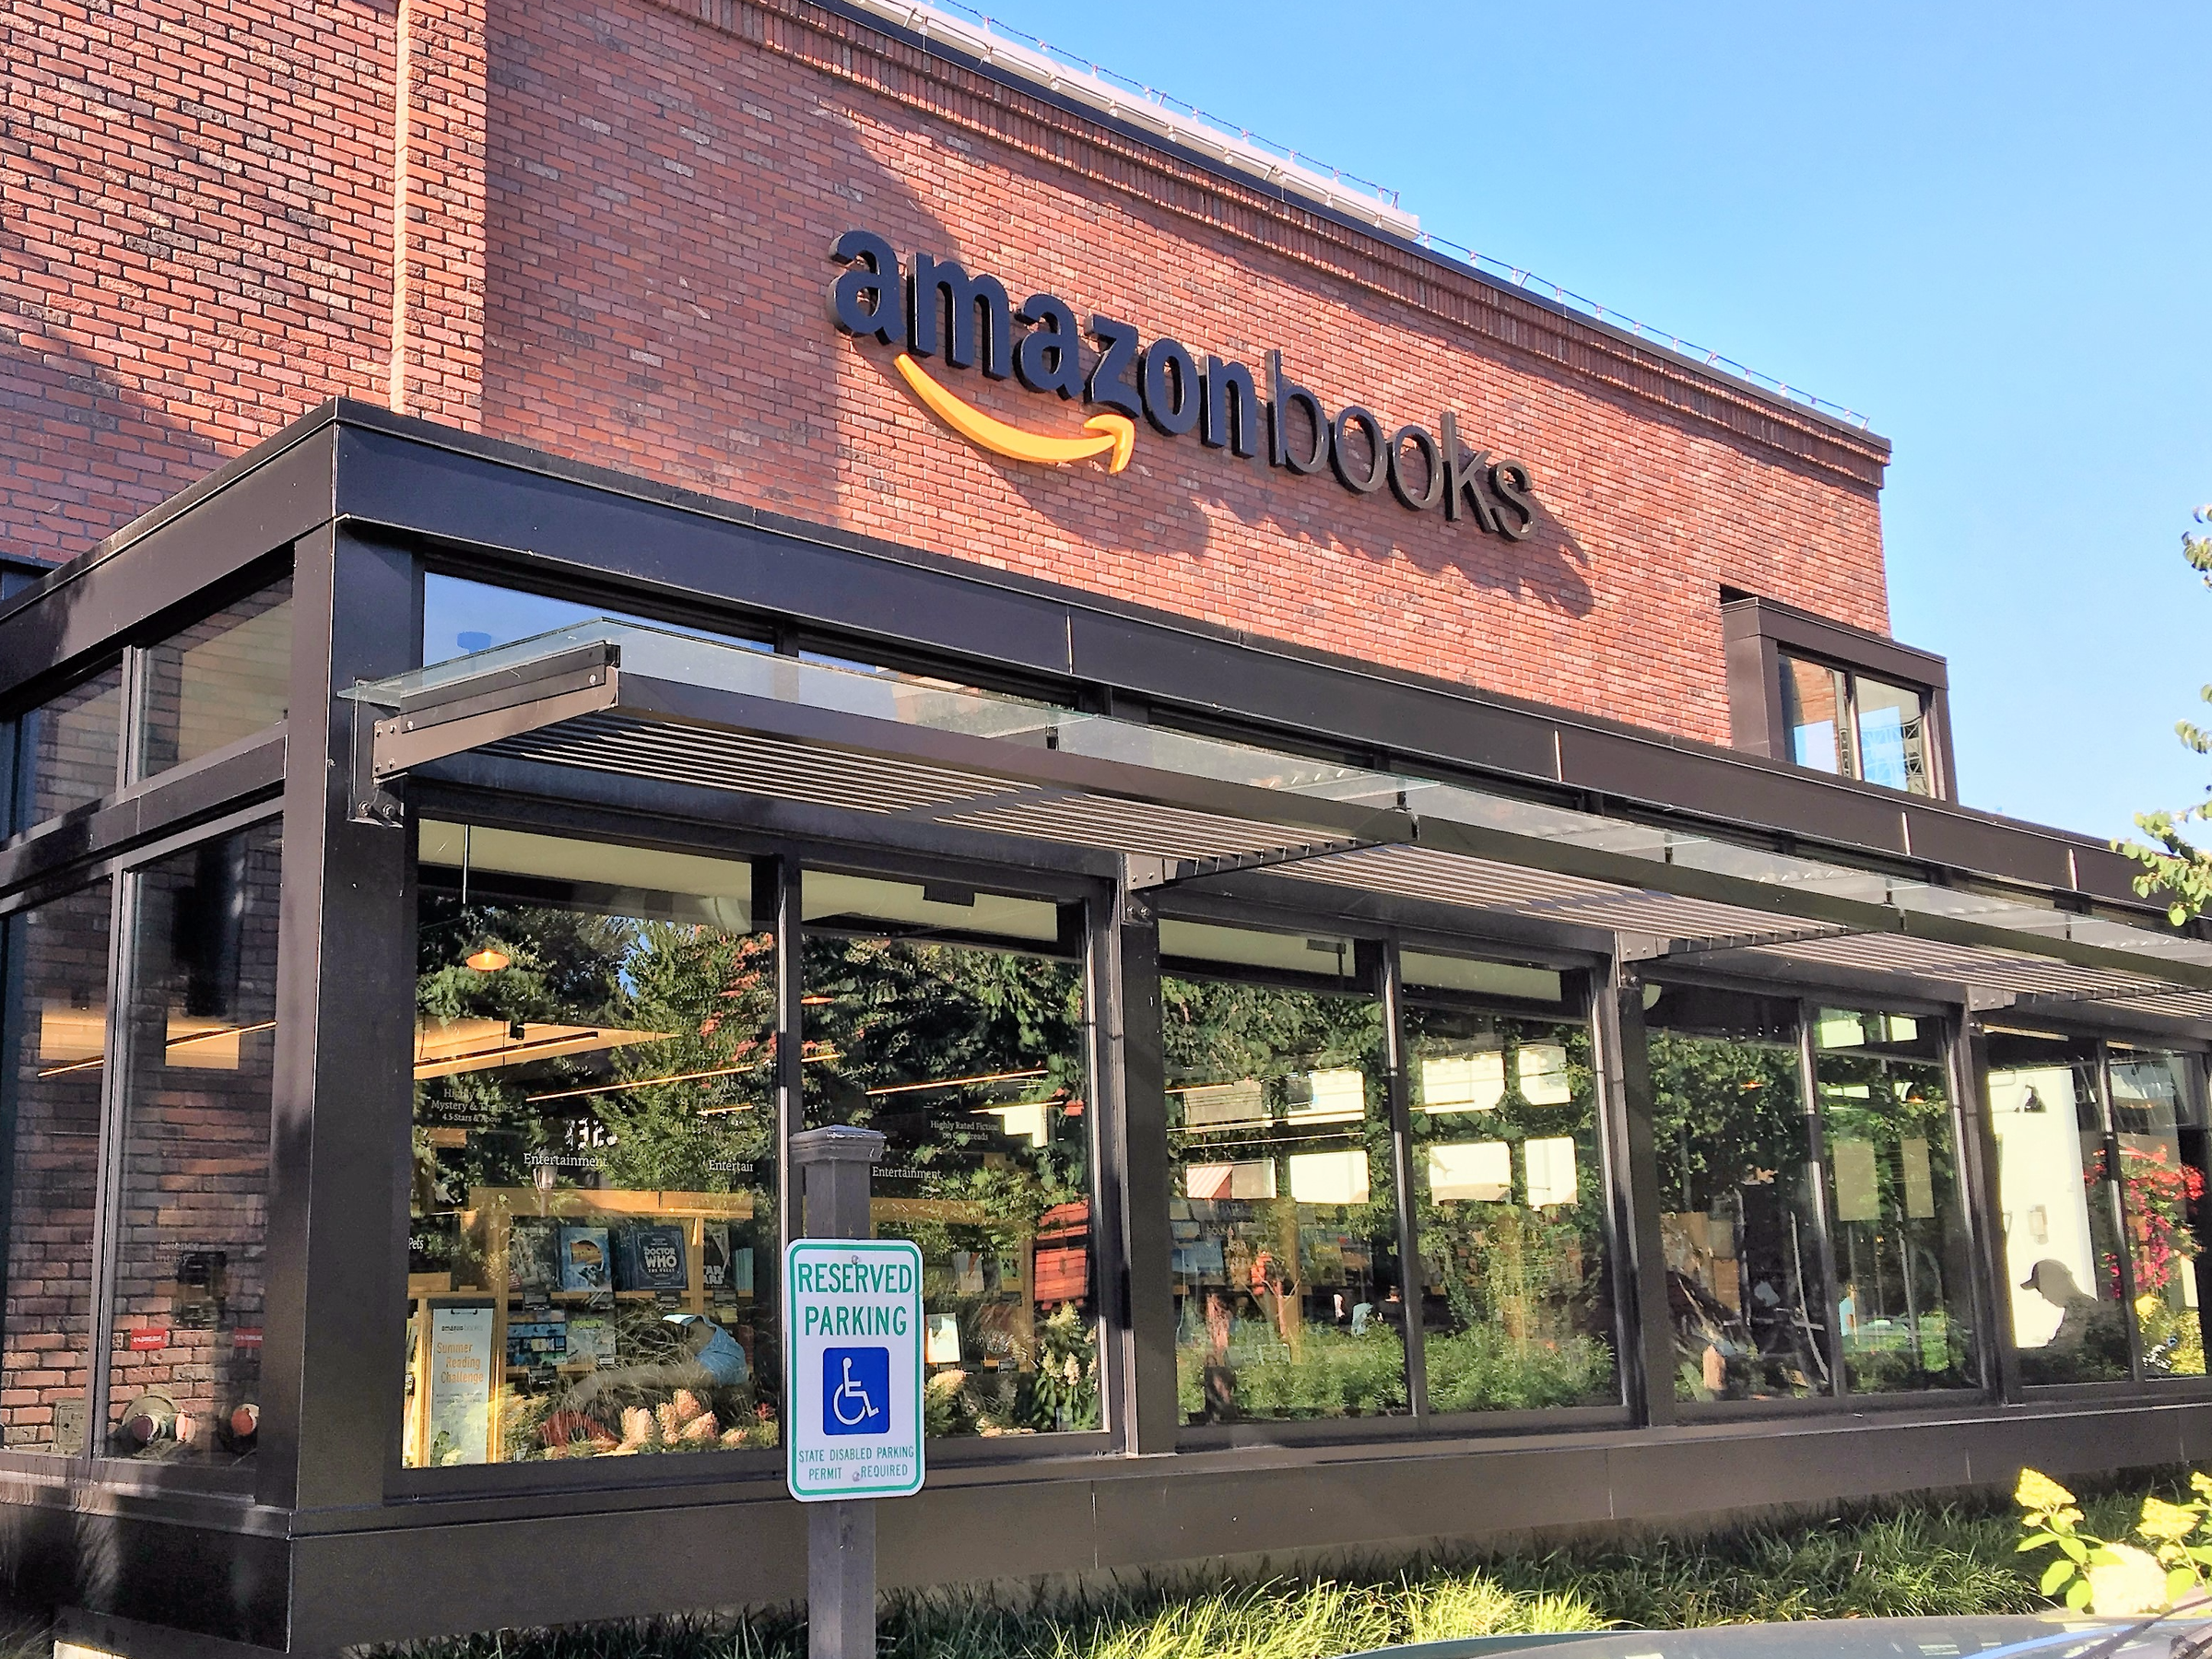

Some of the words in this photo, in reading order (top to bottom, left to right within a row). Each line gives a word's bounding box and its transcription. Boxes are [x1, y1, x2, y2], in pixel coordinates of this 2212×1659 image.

[431, 1100, 468, 1112] Mystery
[469, 1101, 478, 1111] &
[454, 1113, 472, 1122] Stars
[479, 1114, 502, 1124] Above
[930, 1120, 954, 1131] Highly
[955, 1121, 974, 1130] Rated
[976, 1122, 999, 1131] Fiction
[524, 1153, 607, 1167] Entertainment
[872, 1166, 943, 1180] Entertainment
[643, 1246, 676, 1255] DOCTOR
[645, 1254, 677, 1268] WHO
[798, 1263, 912, 1293] RESERVED
[805, 1306, 907, 1335] PARKING
[436, 1342, 473, 1354] Summer
[446, 1356, 481, 1371] Reading
[441, 1371, 484, 1384] Challenge
[798, 1450, 825, 1463] STATE
[830, 1448, 872, 1461] DISABLED
[877, 1446, 914, 1459] PARKING
[808, 1467, 841, 1480] PERMIT
[861, 1464, 908, 1477] REQUIRED
